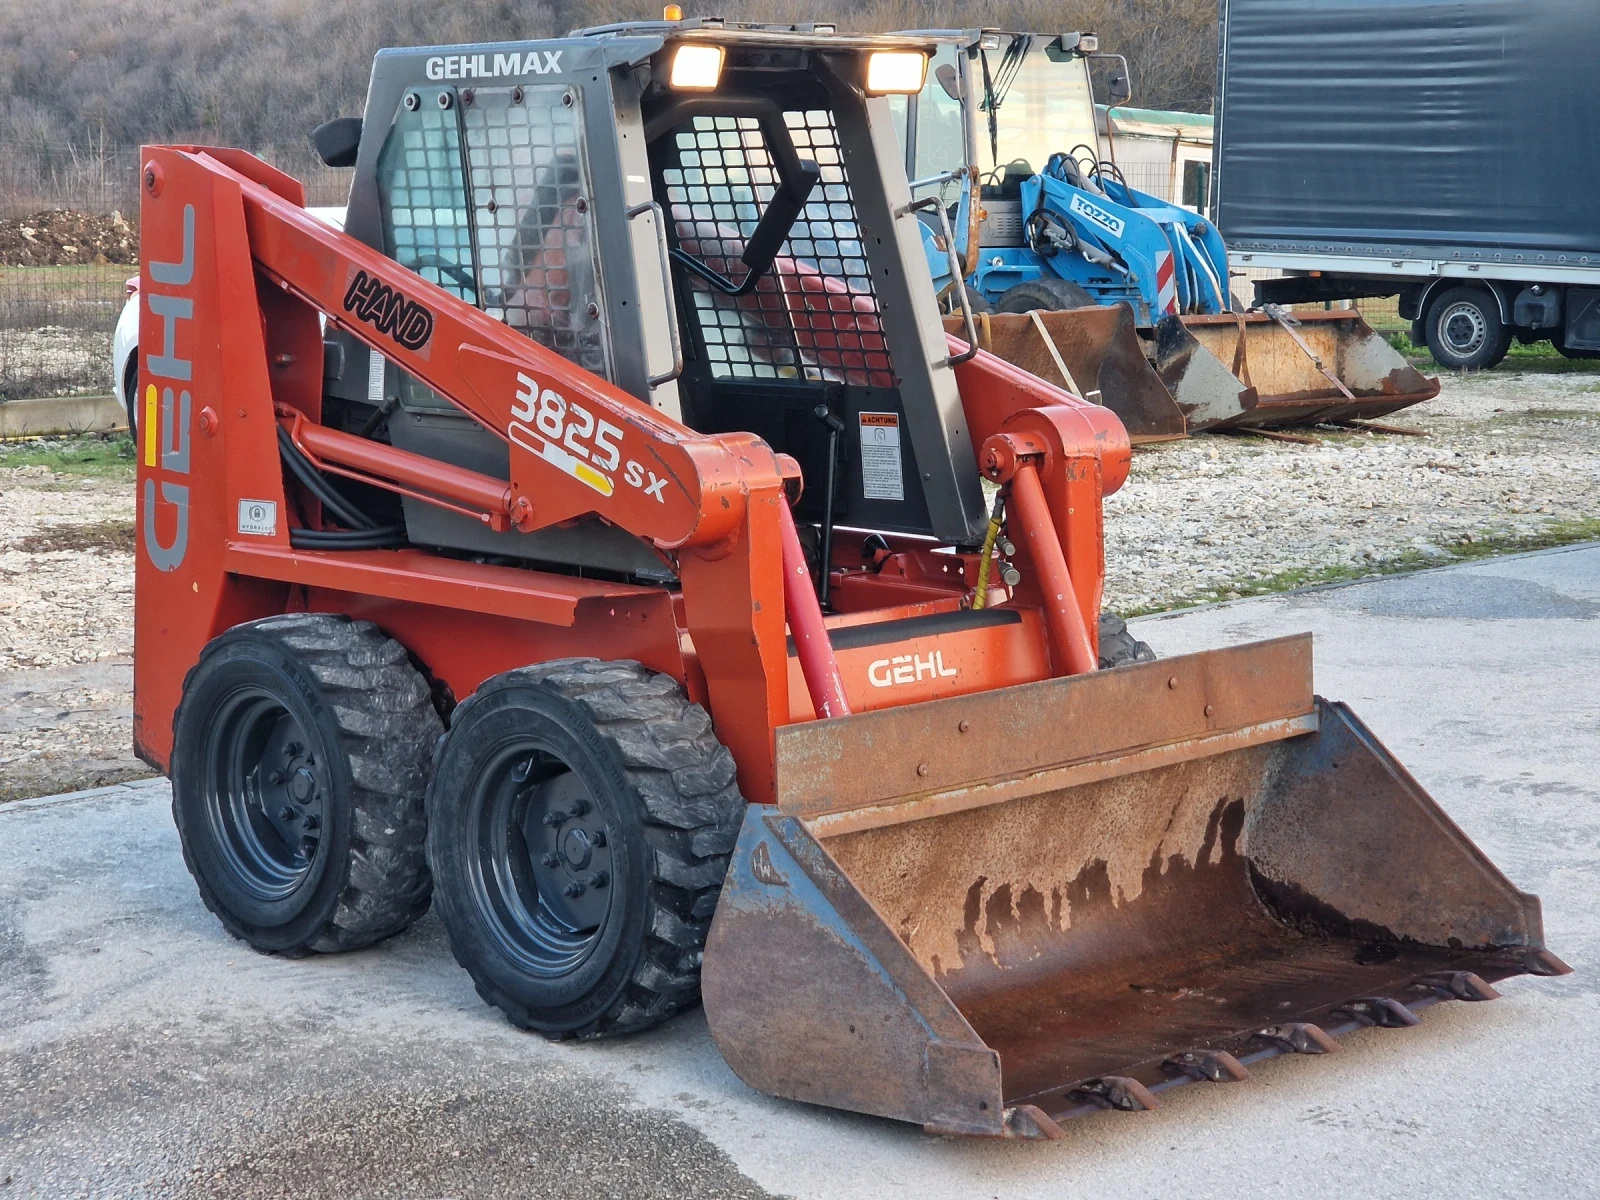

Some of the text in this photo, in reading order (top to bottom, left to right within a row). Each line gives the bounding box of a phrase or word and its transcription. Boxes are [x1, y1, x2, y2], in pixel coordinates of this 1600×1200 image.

[426, 50, 563, 81] GEHLMAX
[343, 270, 433, 350] HAND
[144, 203, 195, 572] GEHL
[510, 372, 624, 472] 3825
[867, 415, 897, 424] ACHTUNG
[868, 650, 957, 687] GEHL
